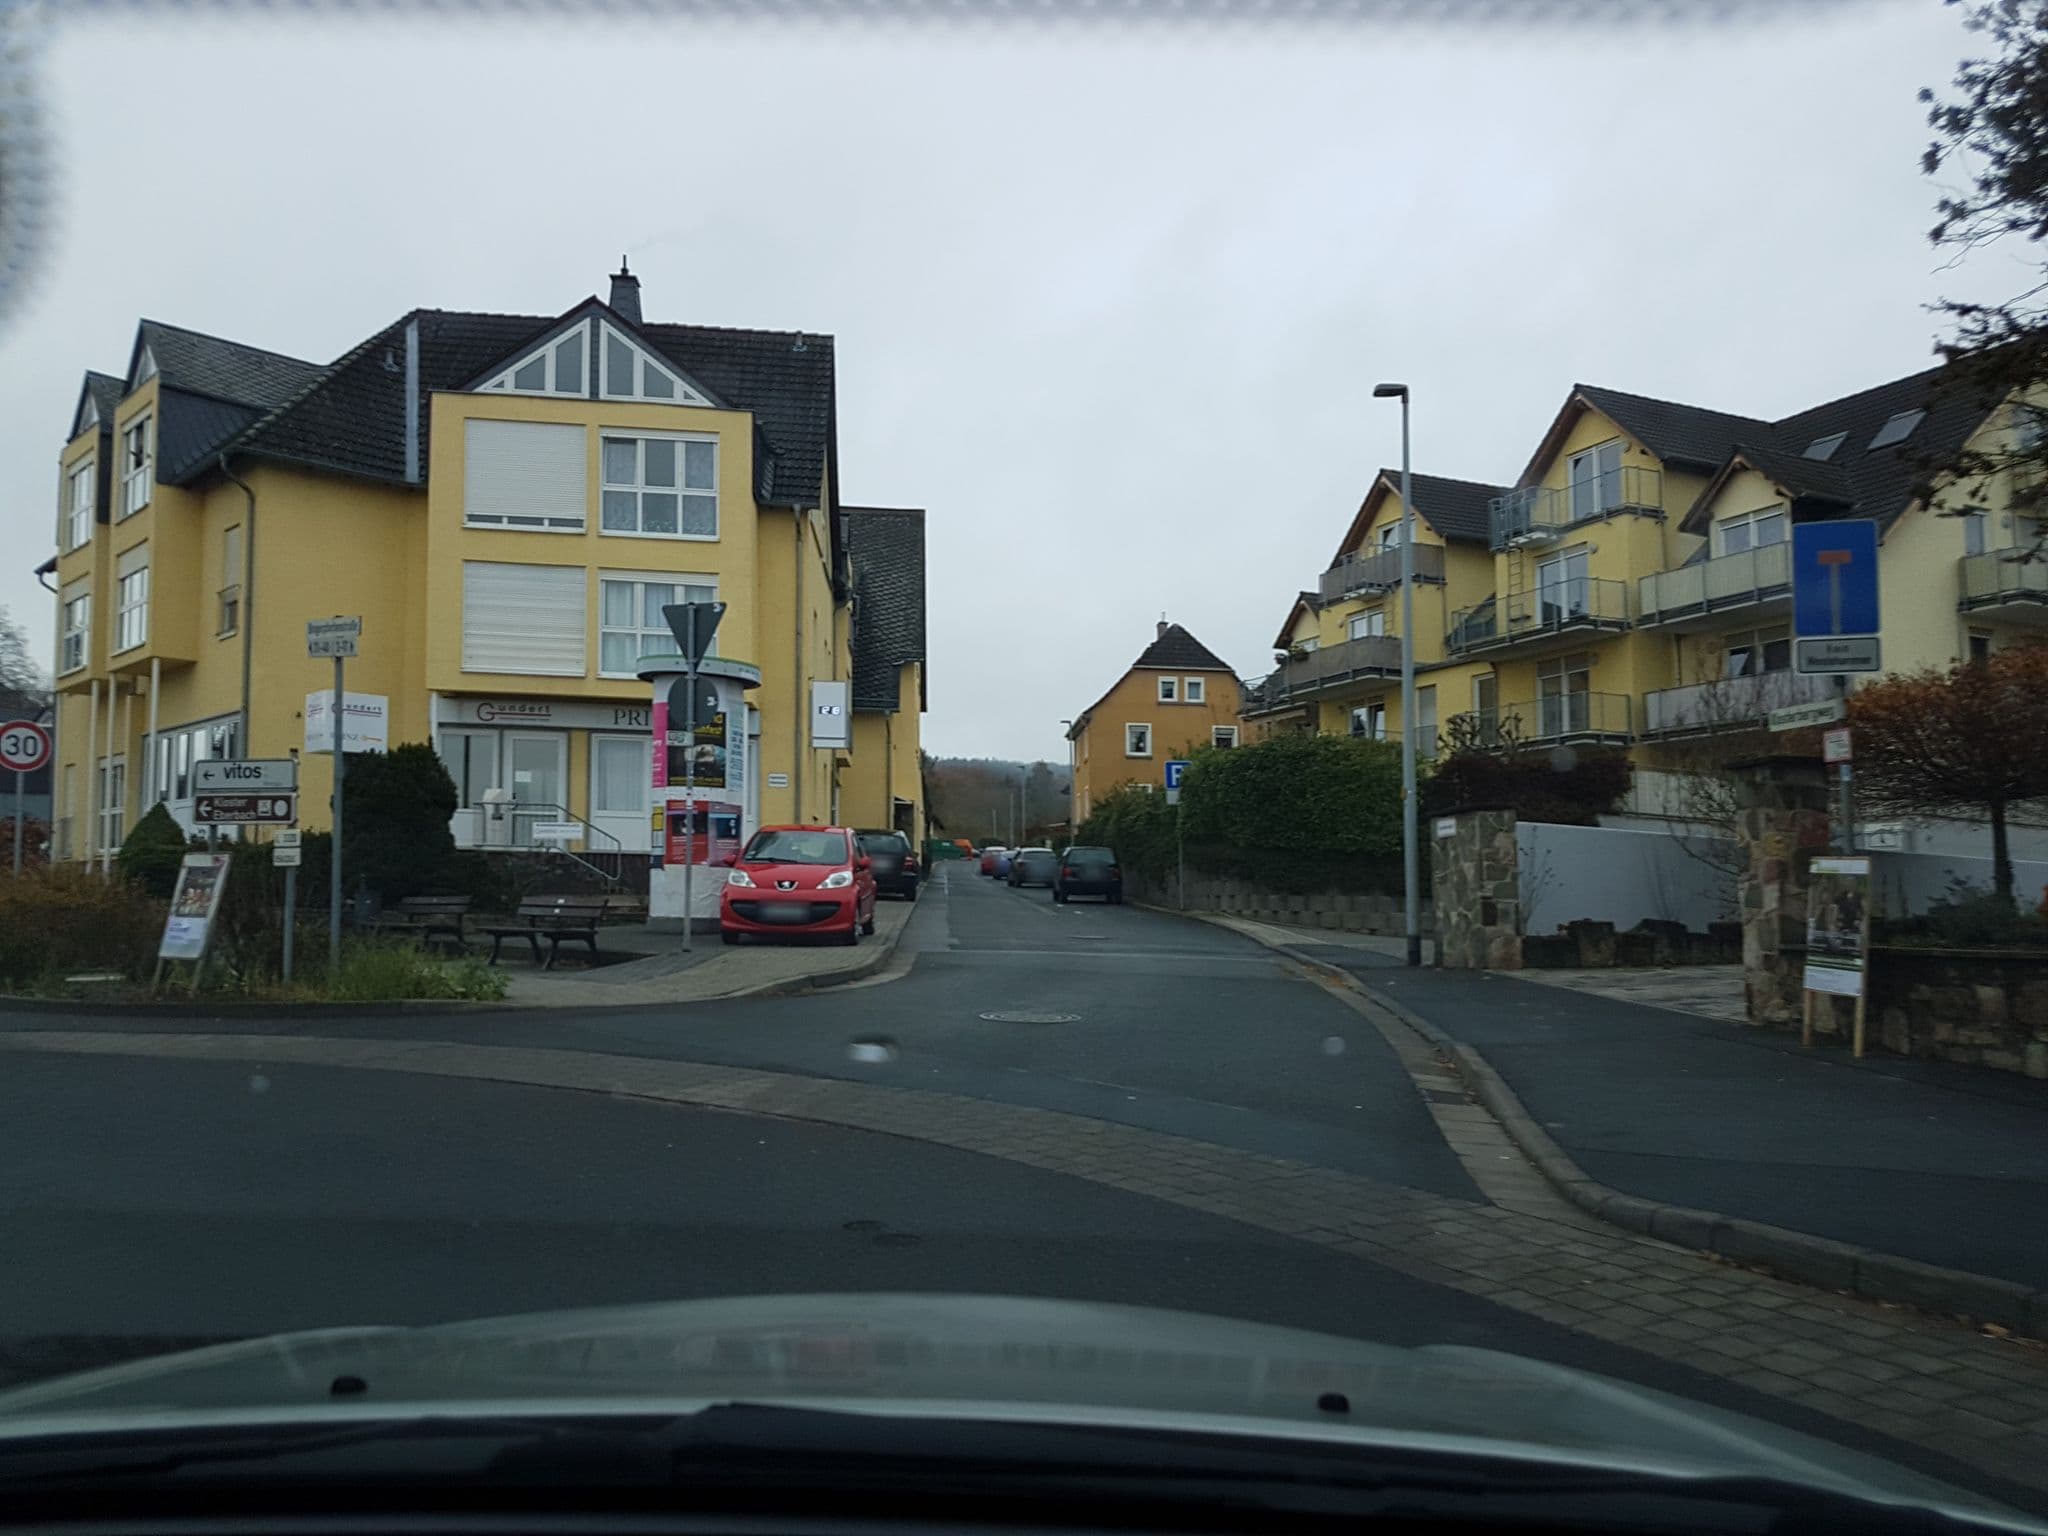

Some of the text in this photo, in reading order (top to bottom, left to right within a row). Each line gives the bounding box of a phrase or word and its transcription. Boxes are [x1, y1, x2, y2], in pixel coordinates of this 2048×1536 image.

[477, 702, 551, 722] Gundert
[613, 708, 650, 726] PRI
[6, 734, 37, 757] 30
[224, 762, 262, 779] vitos
